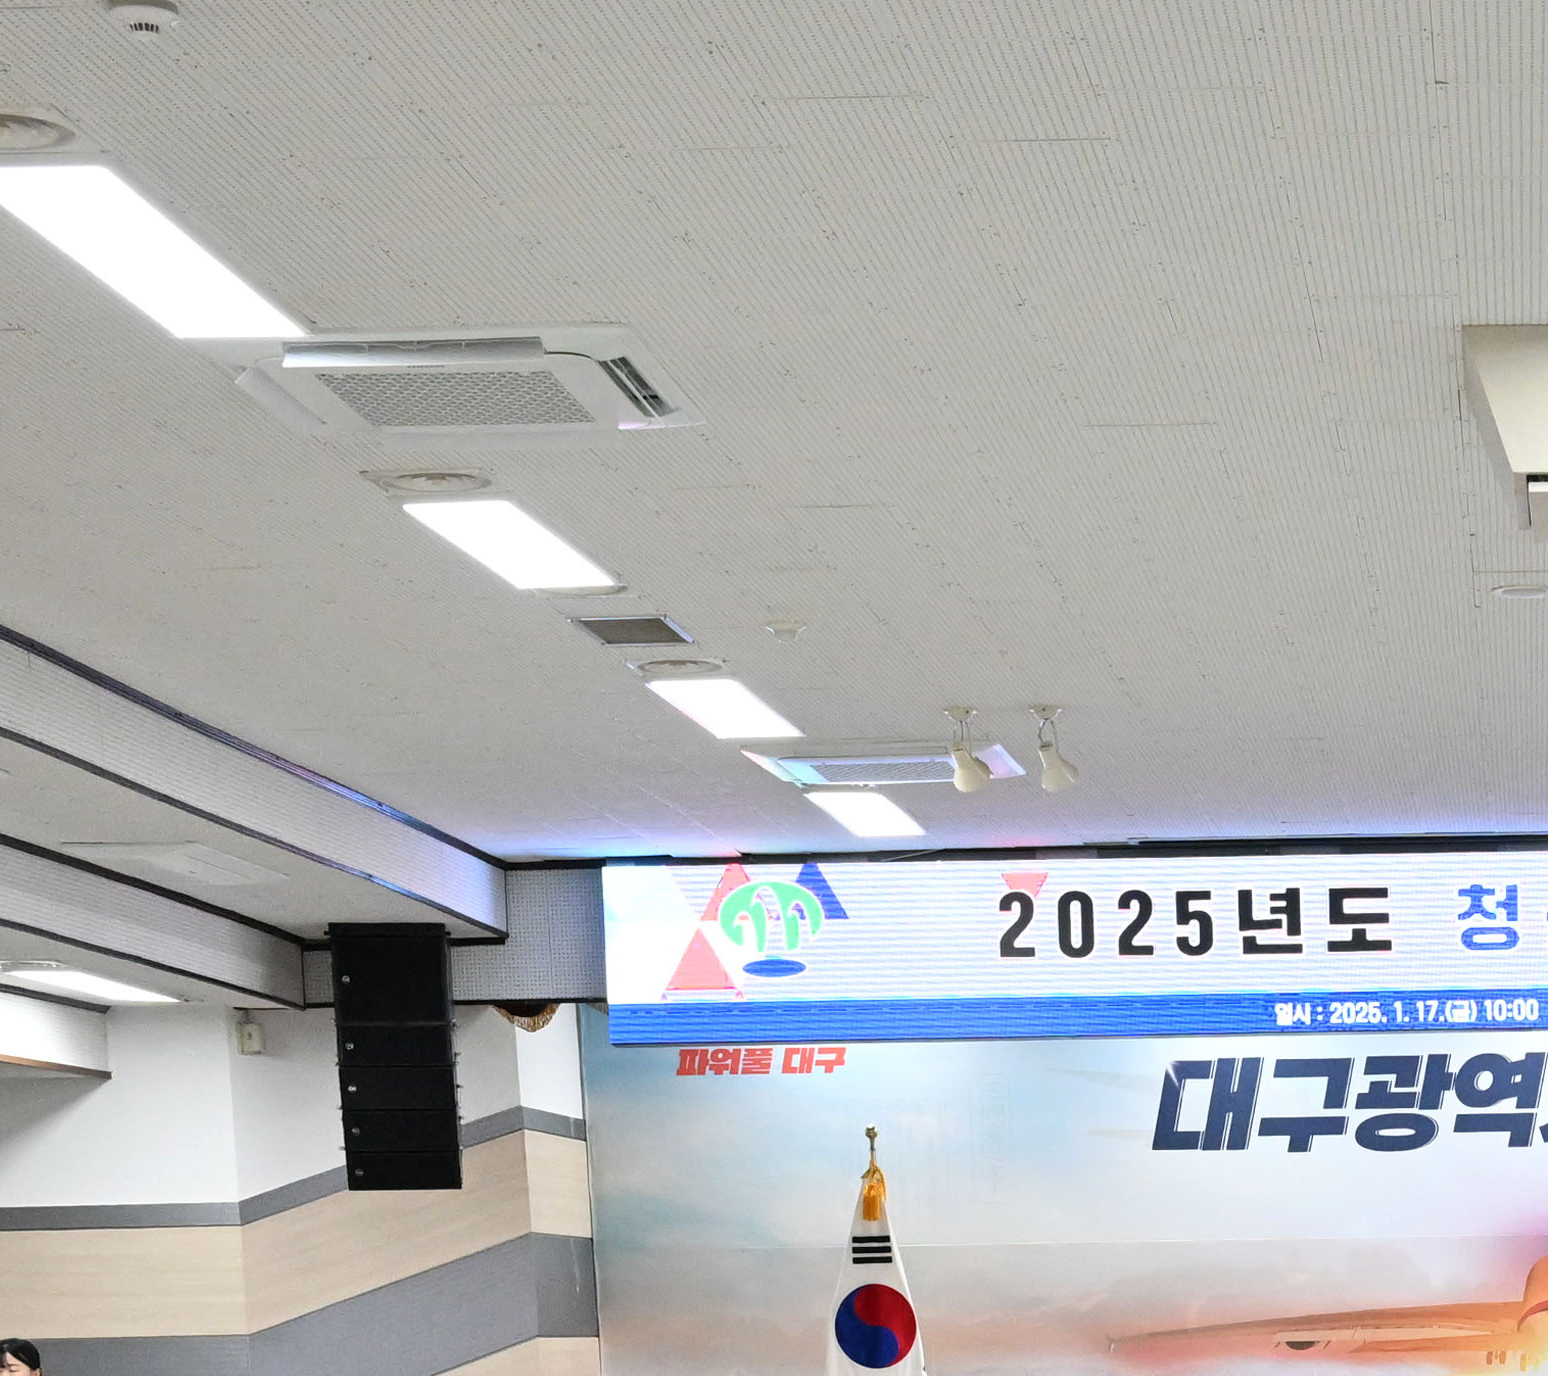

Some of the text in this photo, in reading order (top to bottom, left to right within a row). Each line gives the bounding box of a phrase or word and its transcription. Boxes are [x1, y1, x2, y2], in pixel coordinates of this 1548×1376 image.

[999, 886, 1393, 959] 2025년도
[1275, 1002, 1311, 1026] 일시
[1485, 998, 1539, 1022] 10:00
[676, 1047, 848, 1078] 파워풀 대구
